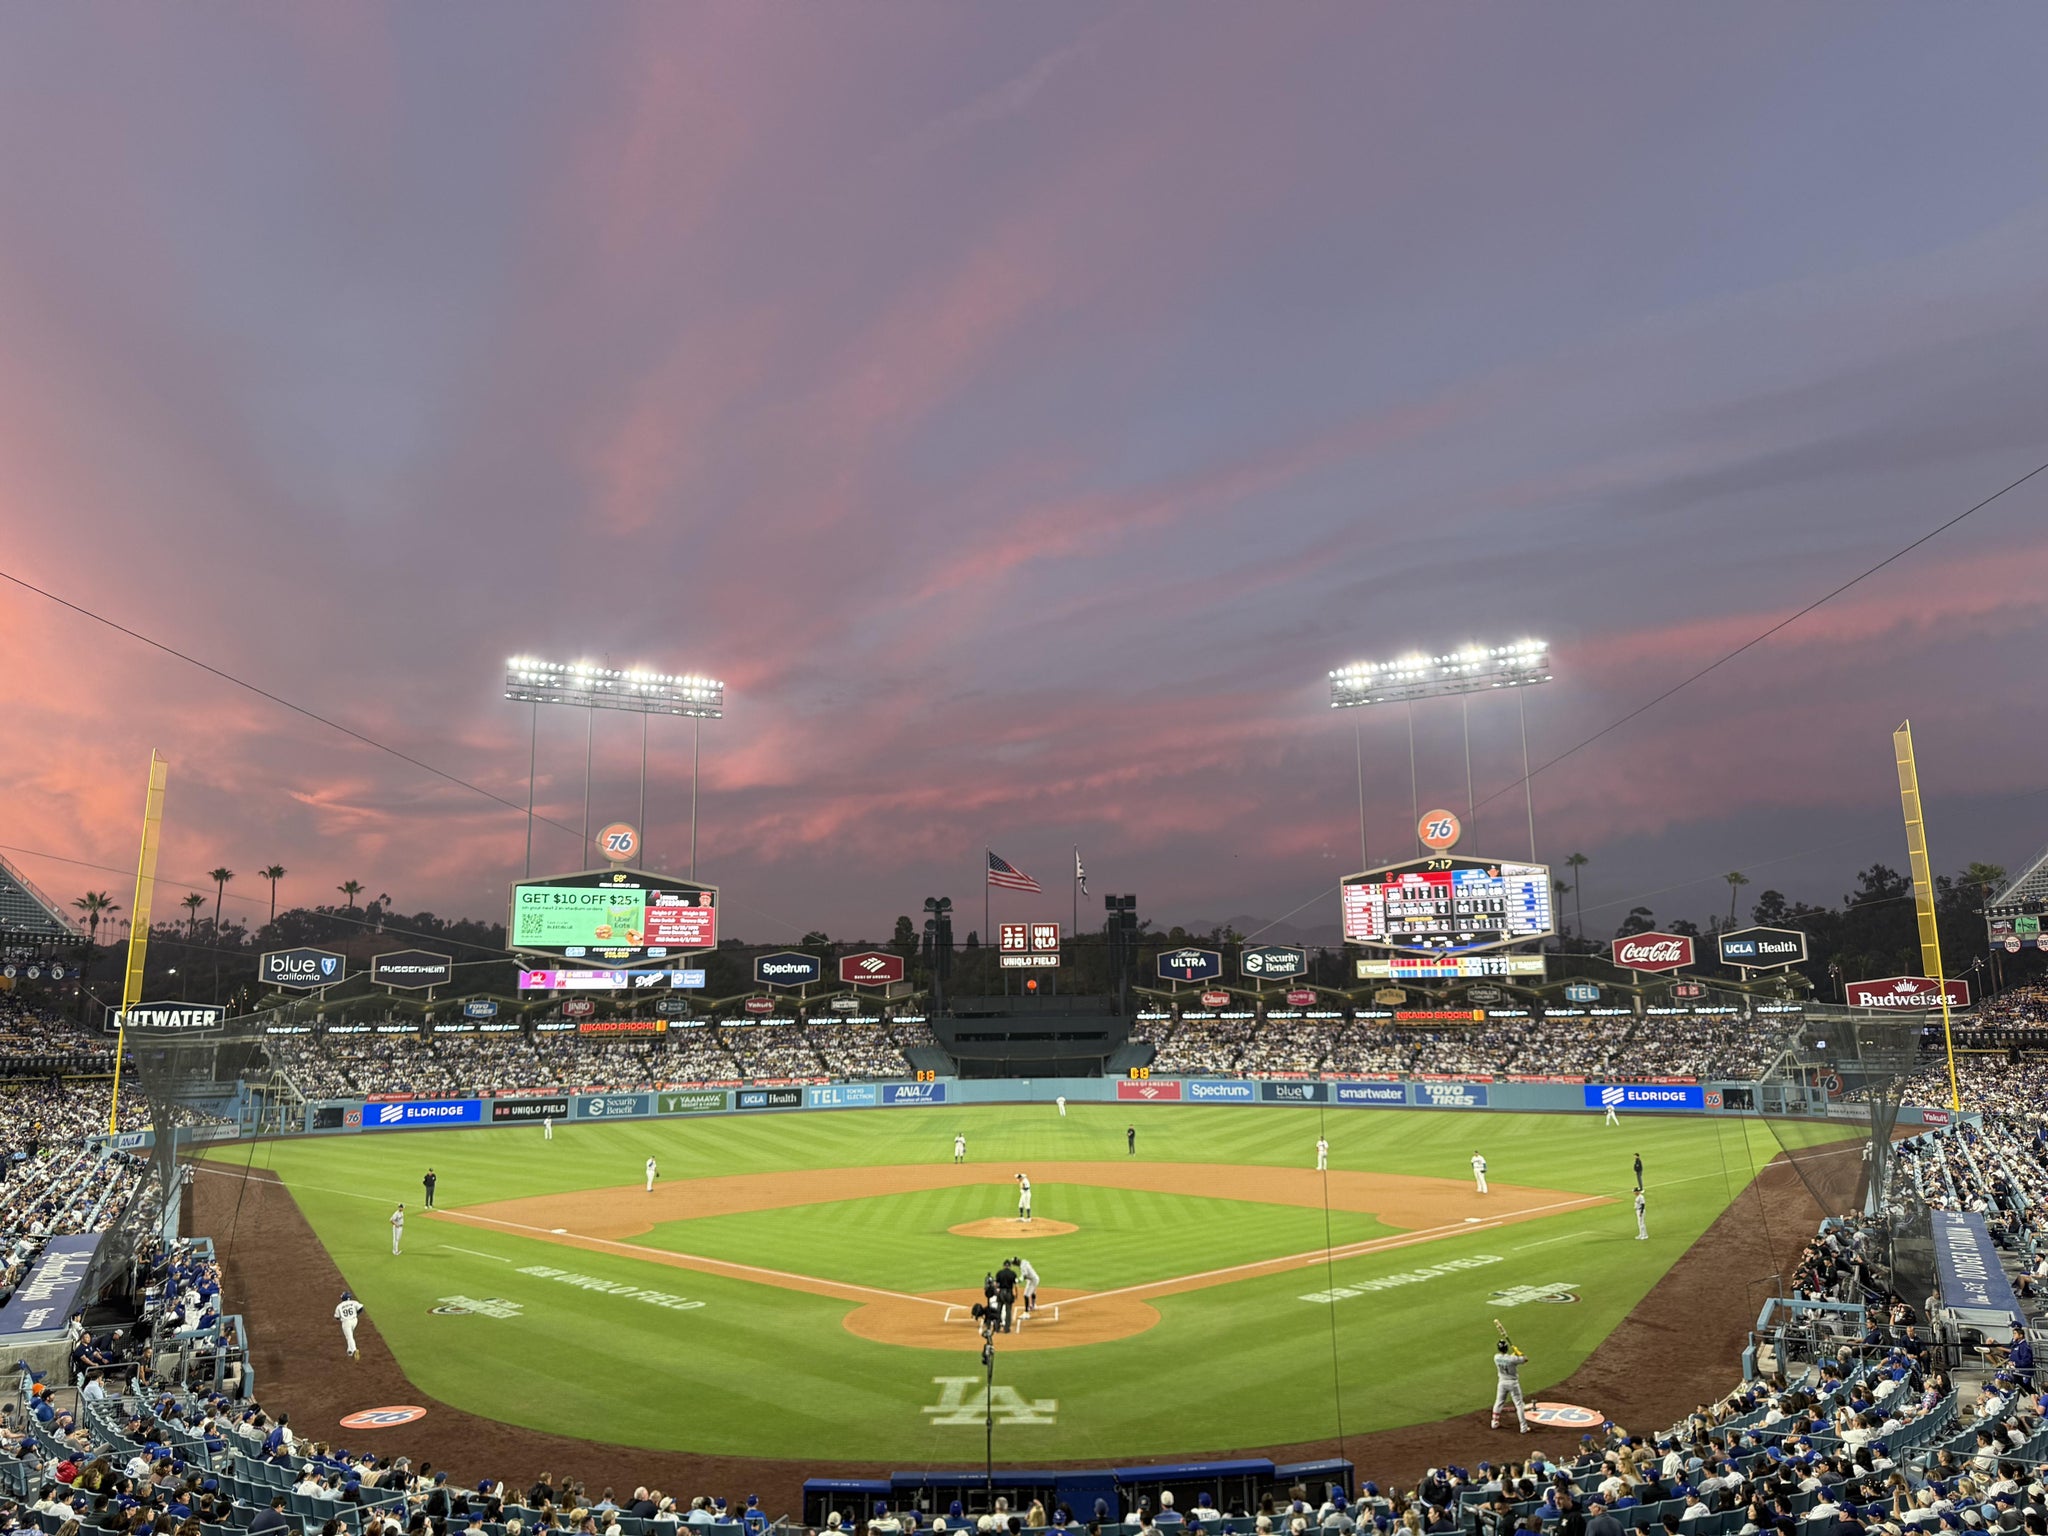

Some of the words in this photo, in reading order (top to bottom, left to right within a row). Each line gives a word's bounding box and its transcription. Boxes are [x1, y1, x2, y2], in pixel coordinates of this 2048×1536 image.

[1426, 818, 1453, 840] 76
[606, 832, 634, 853] 76
[1428, 859, 1453, 870] 7:17
[522, 893, 550, 903] GET
[553, 893, 577, 904] $10
[580, 894, 607, 904] OFF
[609, 894, 640, 906] $25+
[1034, 926, 1054, 938] UNI
[1034, 937, 1056, 949] QLO
[1725, 944, 1753, 954] UCLA
[1758, 941, 1798, 953] Health
[1620, 941, 1684, 963] Coca-Cola
[270, 955, 316, 973] blue
[1003, 957, 1032, 966] UNIQLO
[1033, 956, 1057, 965] FIELD
[1170, 957, 1207, 968] ULTRA
[1264, 953, 1300, 964] Security
[380, 965, 445, 974] GUGGENHEIM
[762, 962, 810, 976] Spectrum
[1265, 963, 1295, 972] Benefit
[277, 972, 321, 981] california
[1570, 988, 1596, 999] TEL
[568, 1002, 590, 1012] JINRO
[1396, 1011, 1434, 1019] NIKAIDO
[1434, 1010, 1473, 1019] SHOCHU
[579, 1022, 617, 1032] NIKAIDO
[618, 1021, 655, 1031] SHOCHU
[895, 1086, 920, 1097] ANA
[1191, 1083, 1245, 1097] Spectrum
[1276, 1085, 1302, 1097] blue
[1339, 1088, 1403, 1100] smartwater
[1424, 1085, 1465, 1095] TOYO
[744, 1095, 764, 1104] UCLA
[768, 1093, 797, 1104] Health
[811, 1089, 842, 1105] TEL
[1431, 1095, 1475, 1106] TIRES
[1627, 1091, 1687, 1101] ELDRIDGE
[1706, 1095, 1720, 1105] 76
[606, 1097, 637, 1108] Security
[407, 1106, 464, 1117] ELDRIDGE
[512, 1105, 541, 1115] UNIQLO
[542, 1104, 566, 1113] FIELD
[606, 1106, 633, 1114] Benefit
[346, 1113, 360, 1123] 76
[1923, 1113, 1948, 1123] Yakult
[120, 1137, 136, 1148] ANA
[1950, 1252, 1989, 1280] DODGER
[624, 1290, 706, 1310] FIELD
[342, 1307, 354, 1317] 96
[921, 1376, 1058, 1426] LA
[345, 1409, 423, 1424] 76
[1530, 1406, 1594, 1423] 76
